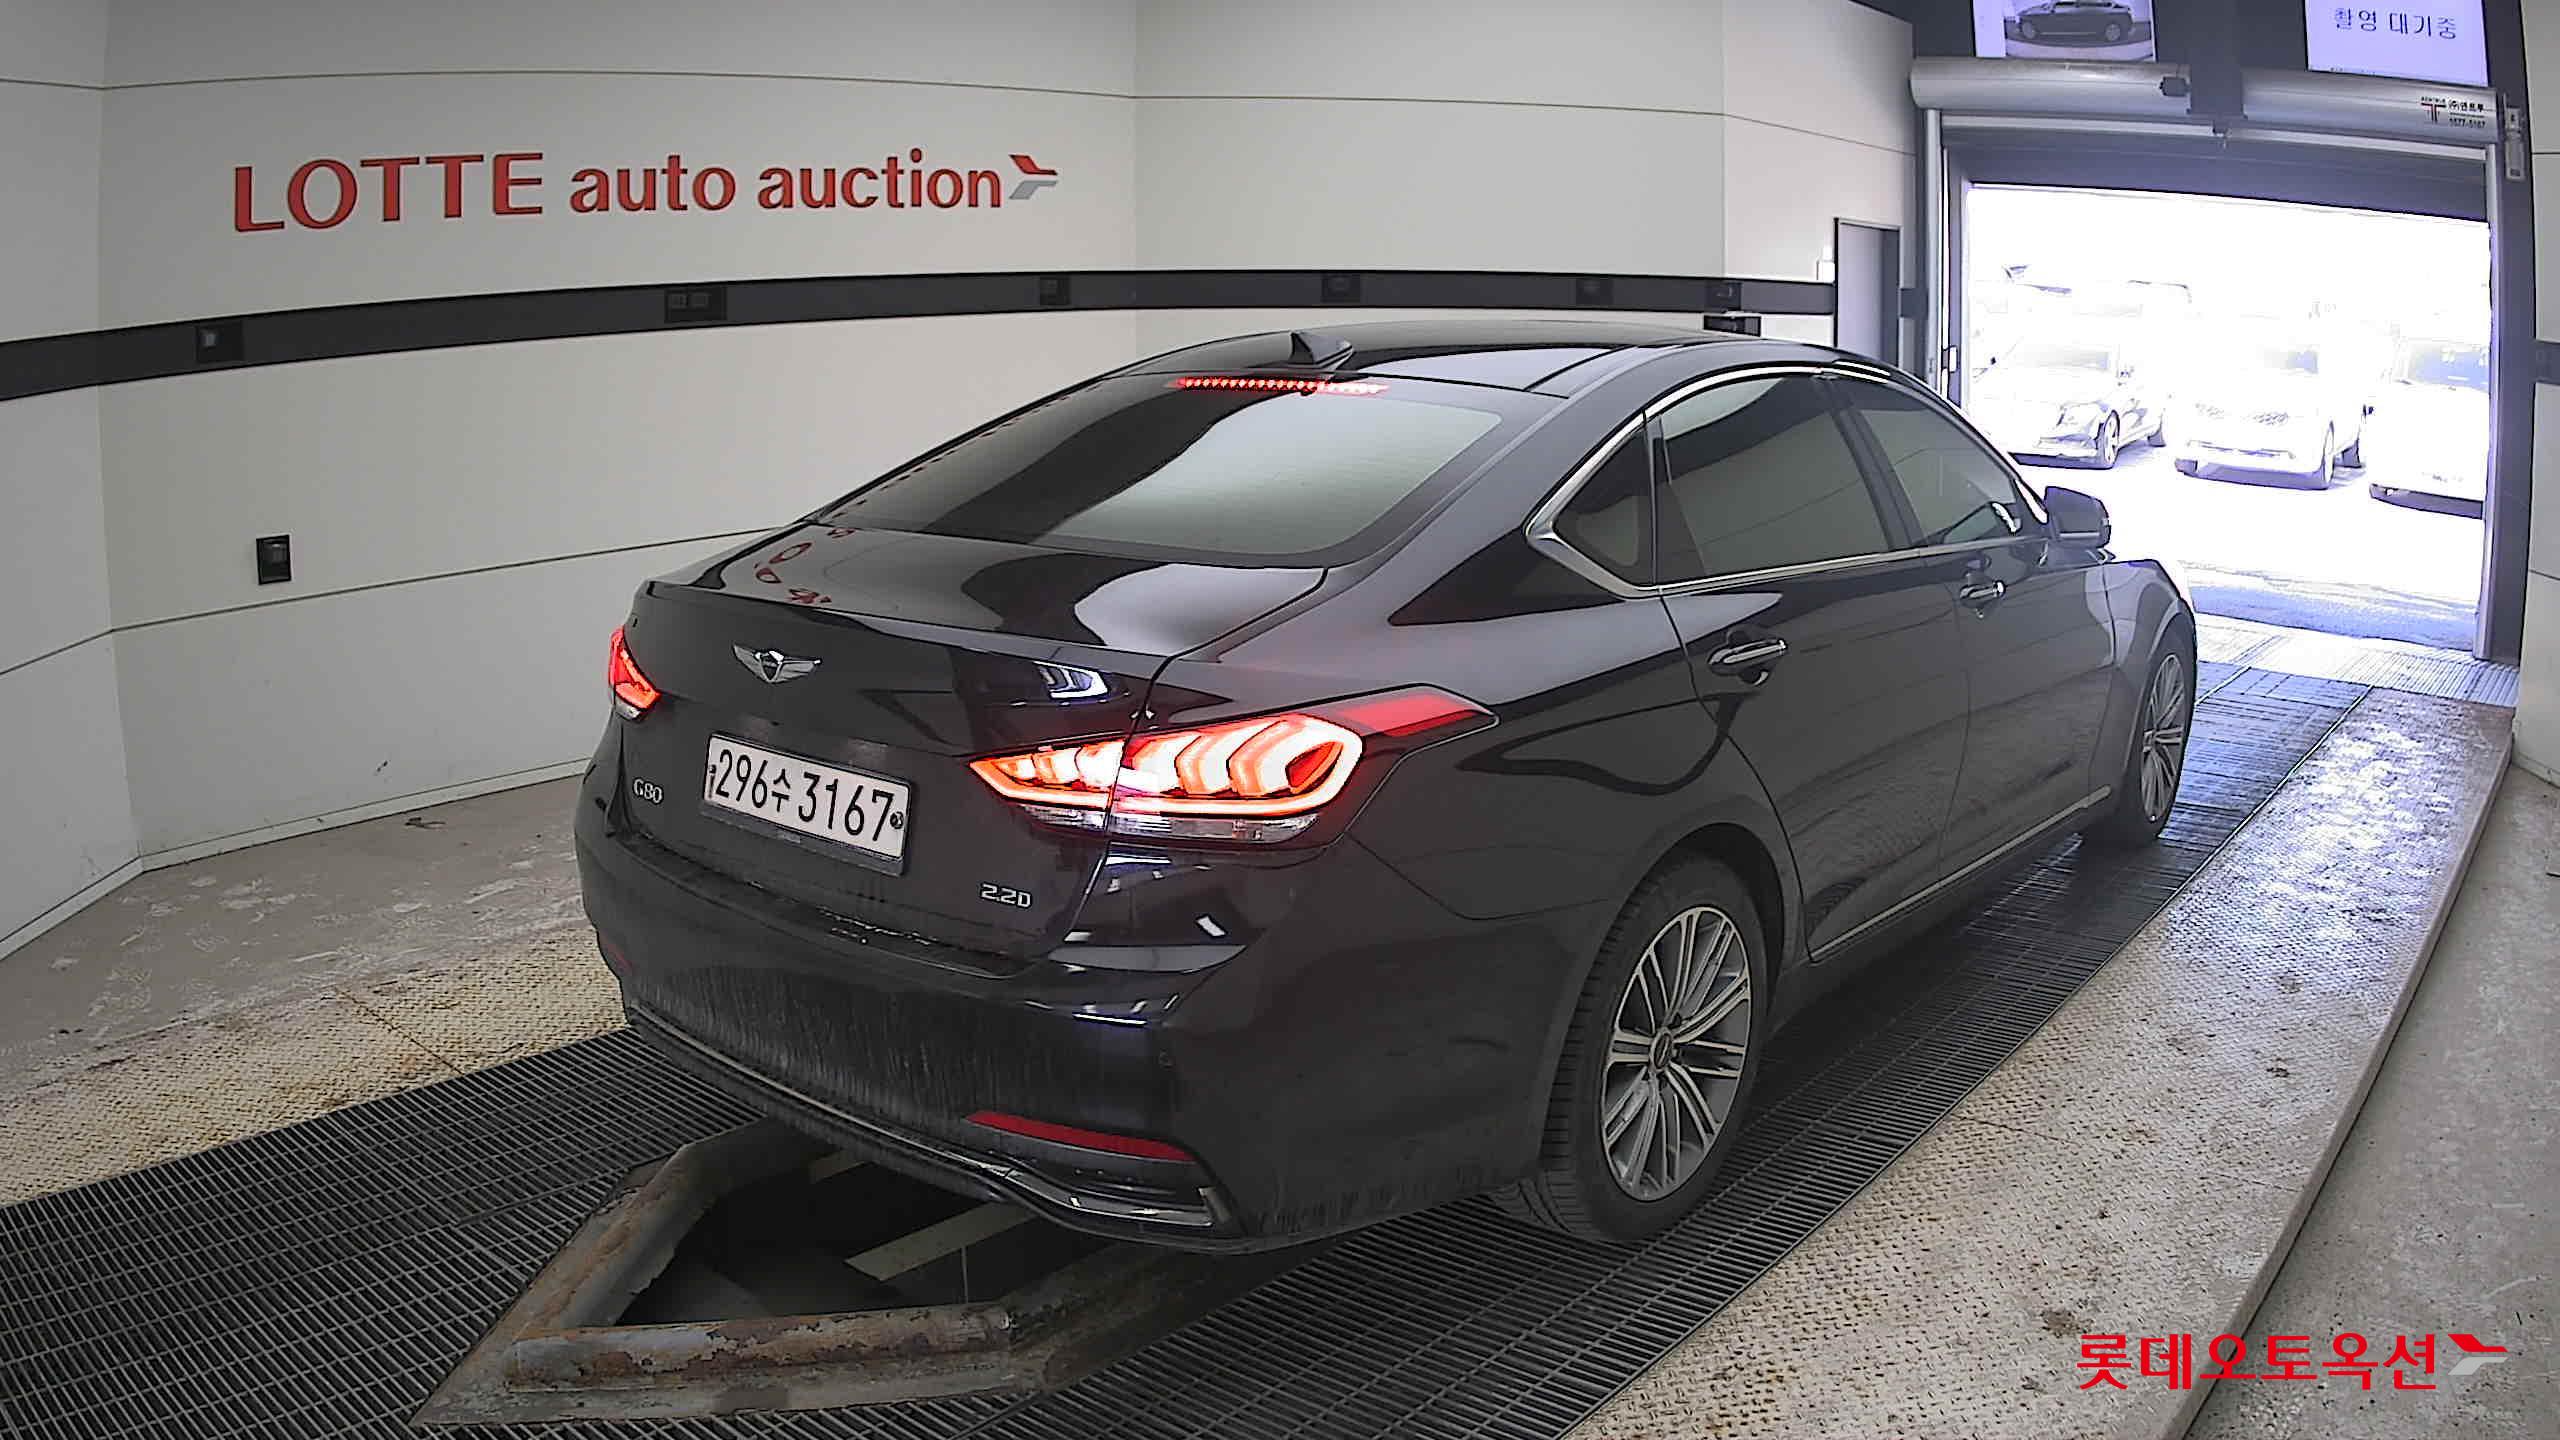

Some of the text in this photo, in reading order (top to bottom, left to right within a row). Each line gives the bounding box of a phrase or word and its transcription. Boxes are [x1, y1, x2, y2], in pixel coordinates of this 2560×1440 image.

[2335, 7, 2457, 40] 촬영 대기중
[235, 147, 1004, 232] LOTTE auto auction
[633, 778, 663, 804] G80
[981, 883, 1031, 908] 2.2D
